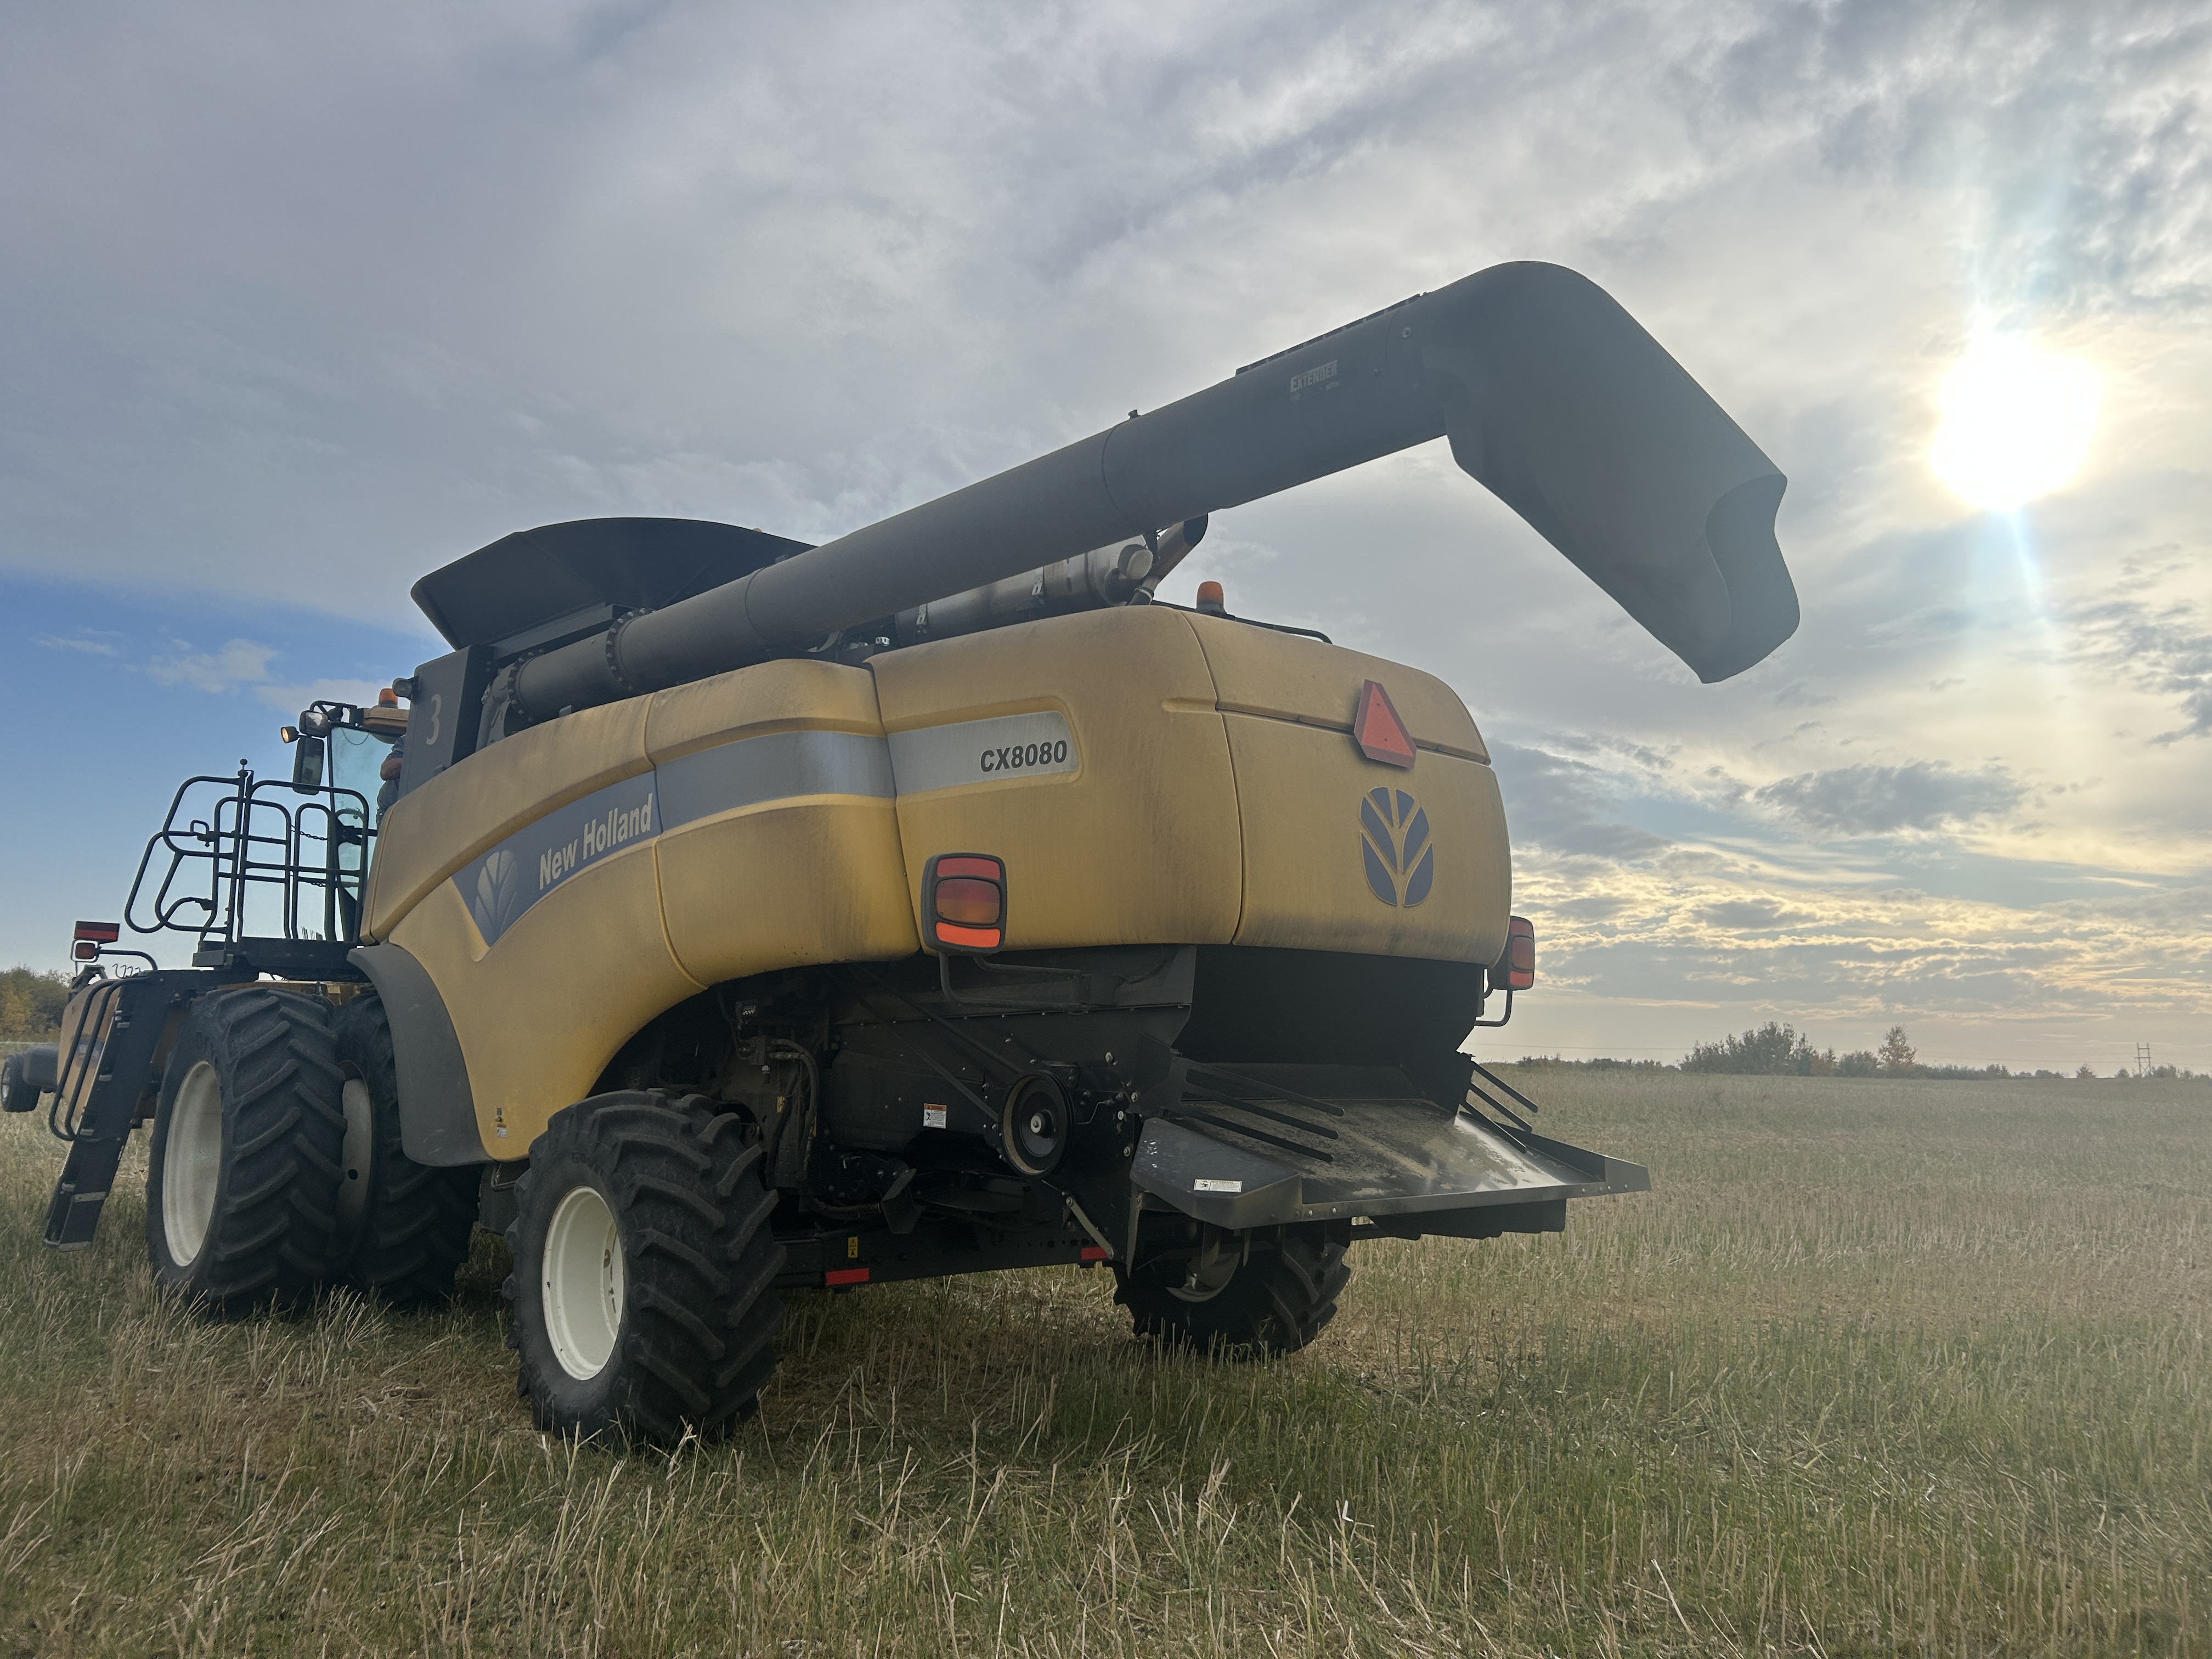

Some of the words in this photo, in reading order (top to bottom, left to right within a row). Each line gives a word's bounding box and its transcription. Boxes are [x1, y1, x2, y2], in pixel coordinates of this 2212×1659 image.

[1290, 360, 1338, 393] EXTENDER
[426, 694, 442, 745] 3
[980, 740, 1067, 772] CX8080
[539, 838, 578, 890] New
[583, 793, 653, 860] Holland
